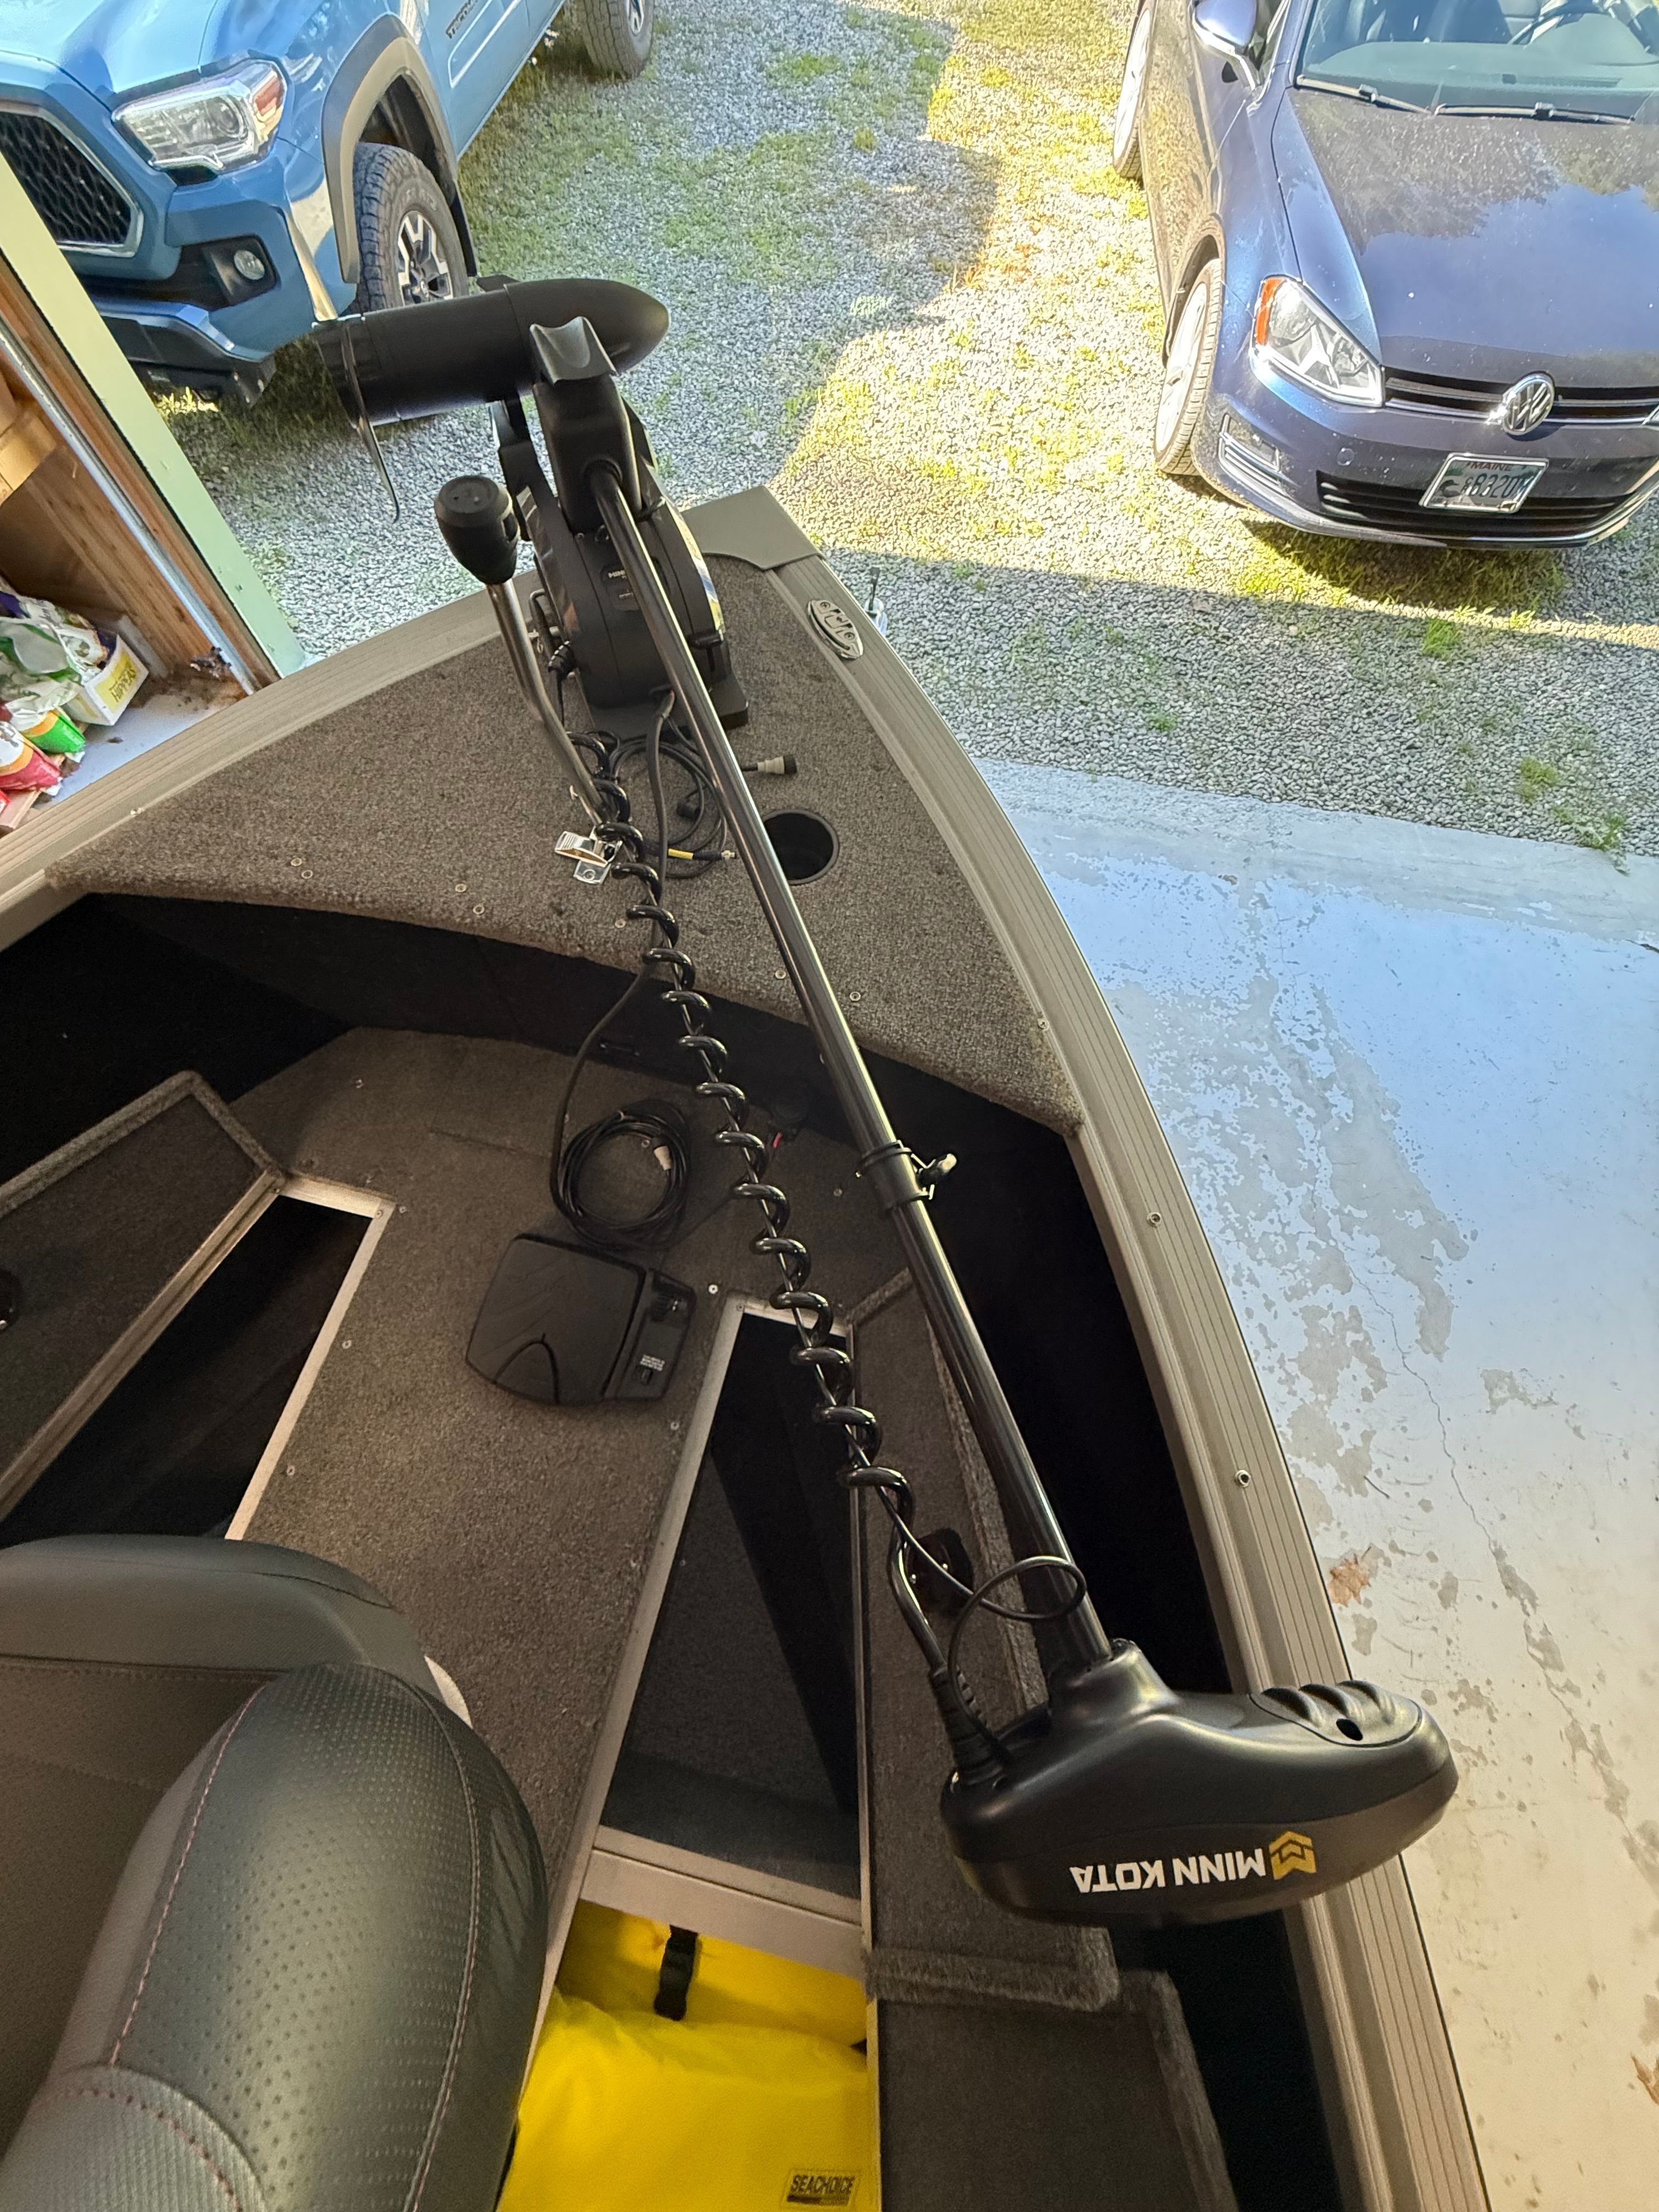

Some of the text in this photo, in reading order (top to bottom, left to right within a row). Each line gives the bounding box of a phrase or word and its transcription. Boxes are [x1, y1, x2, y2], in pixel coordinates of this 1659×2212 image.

[1471, 462, 1513, 471] MAINE
[1069, 1848, 1266, 1893] MINN KOTA
[789, 2174, 856, 2194] SEACHOICE
